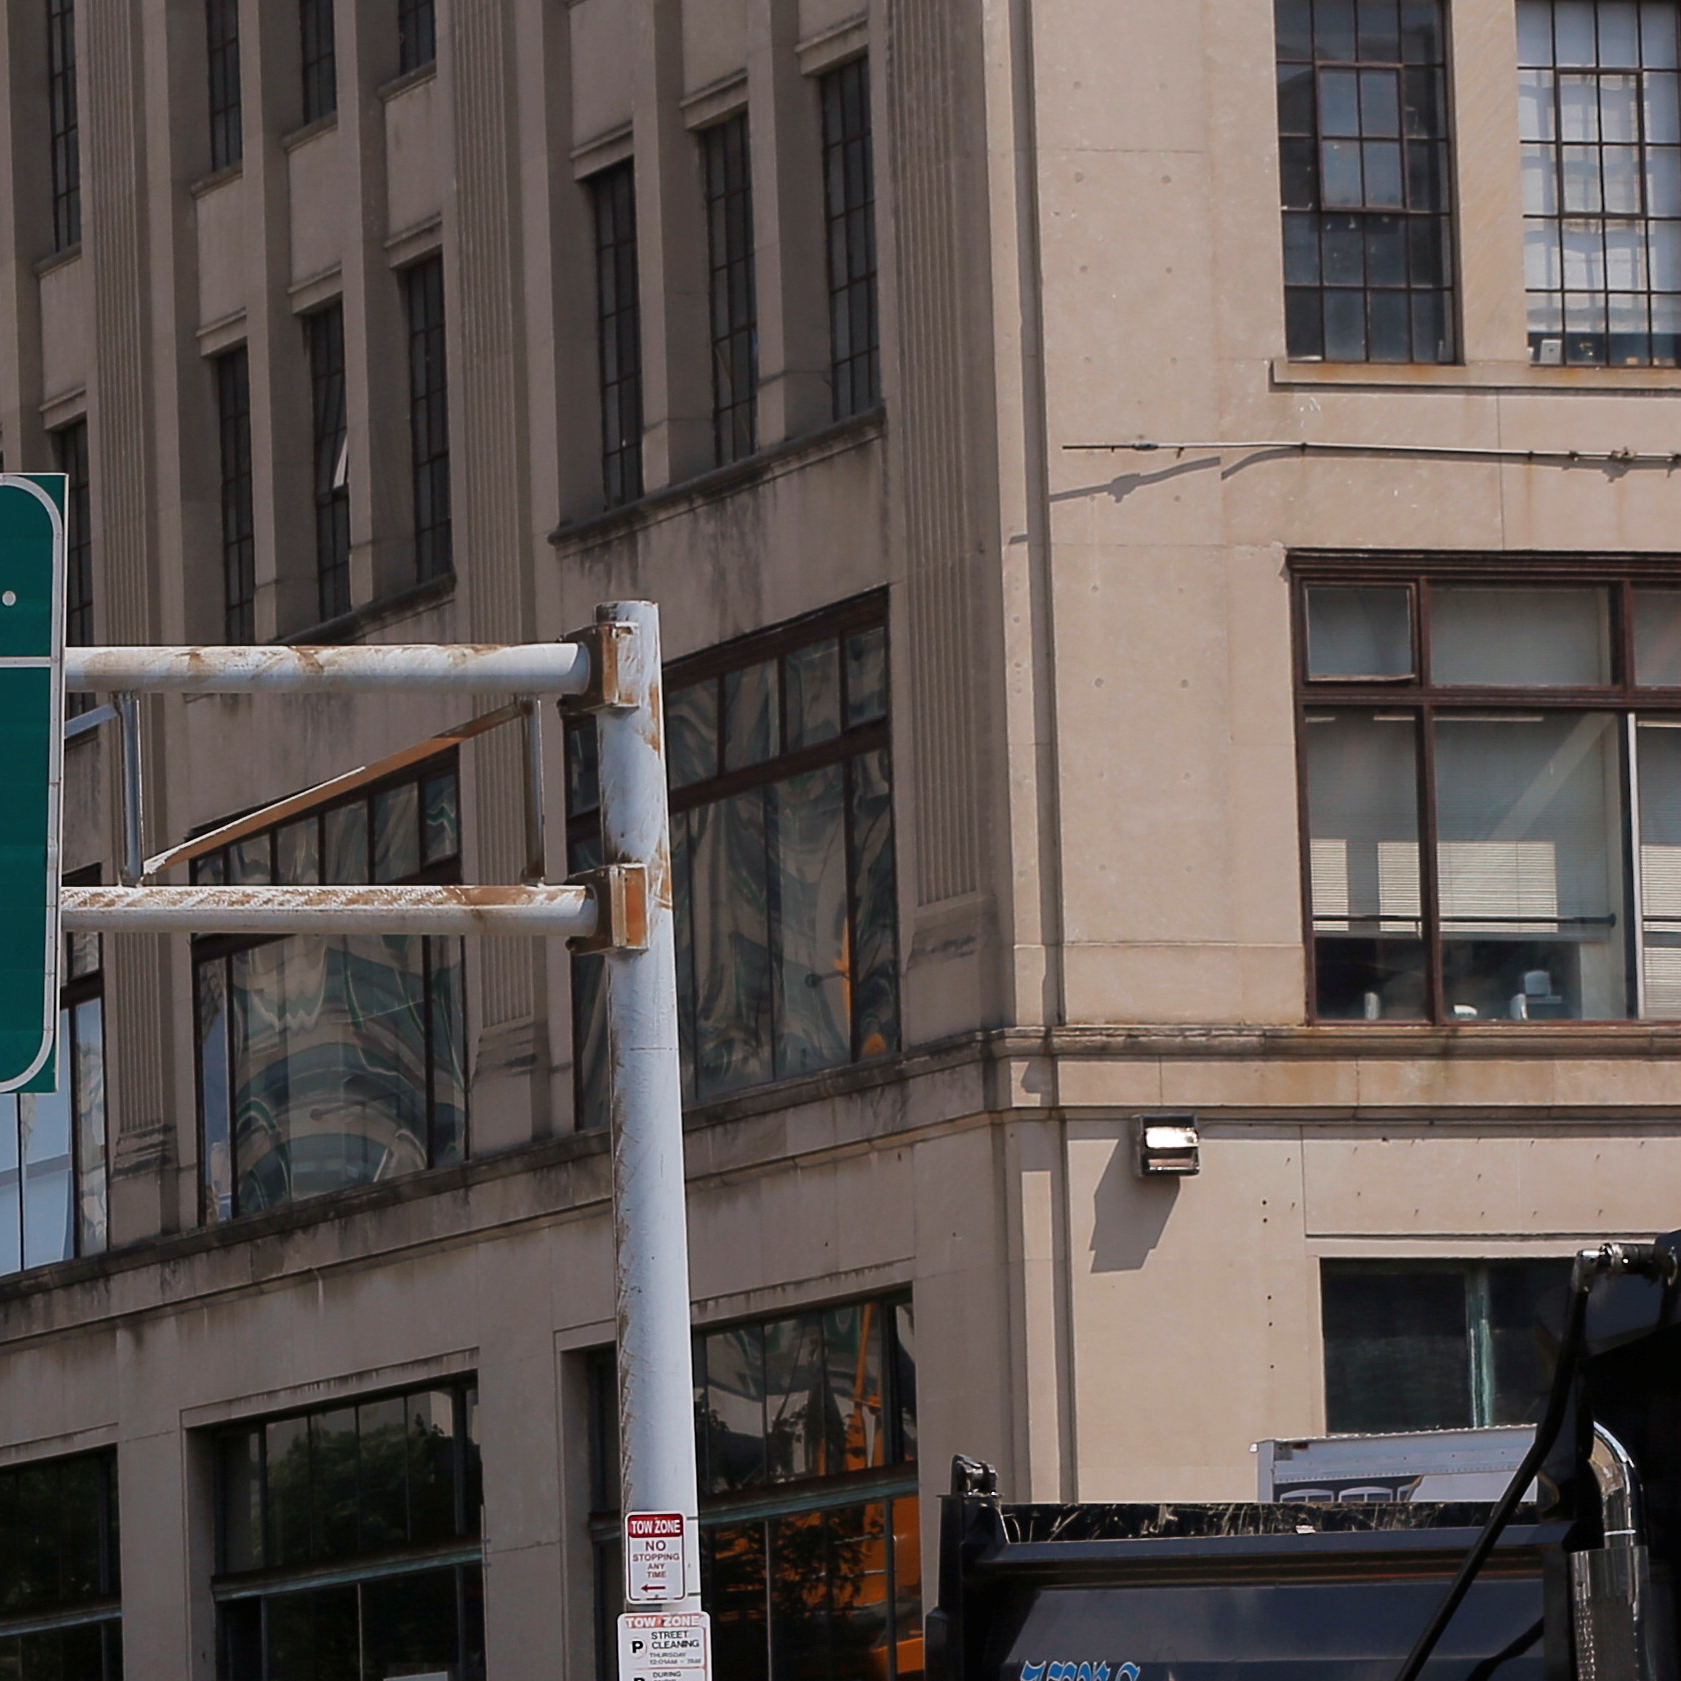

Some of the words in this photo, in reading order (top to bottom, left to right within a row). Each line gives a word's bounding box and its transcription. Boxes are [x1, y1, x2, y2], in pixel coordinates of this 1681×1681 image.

[631, 1520, 653, 1534] TOW
[654, 1520, 680, 1533] ZONE
[645, 1540, 666, 1551] NO
[633, 1553, 680, 1561] STOPPING
[626, 1617, 656, 1628] TOW
[663, 1615, 700, 1626] ZONE
[651, 1631, 688, 1640] STREET
[652, 1640, 699, 1649] CLEANING
